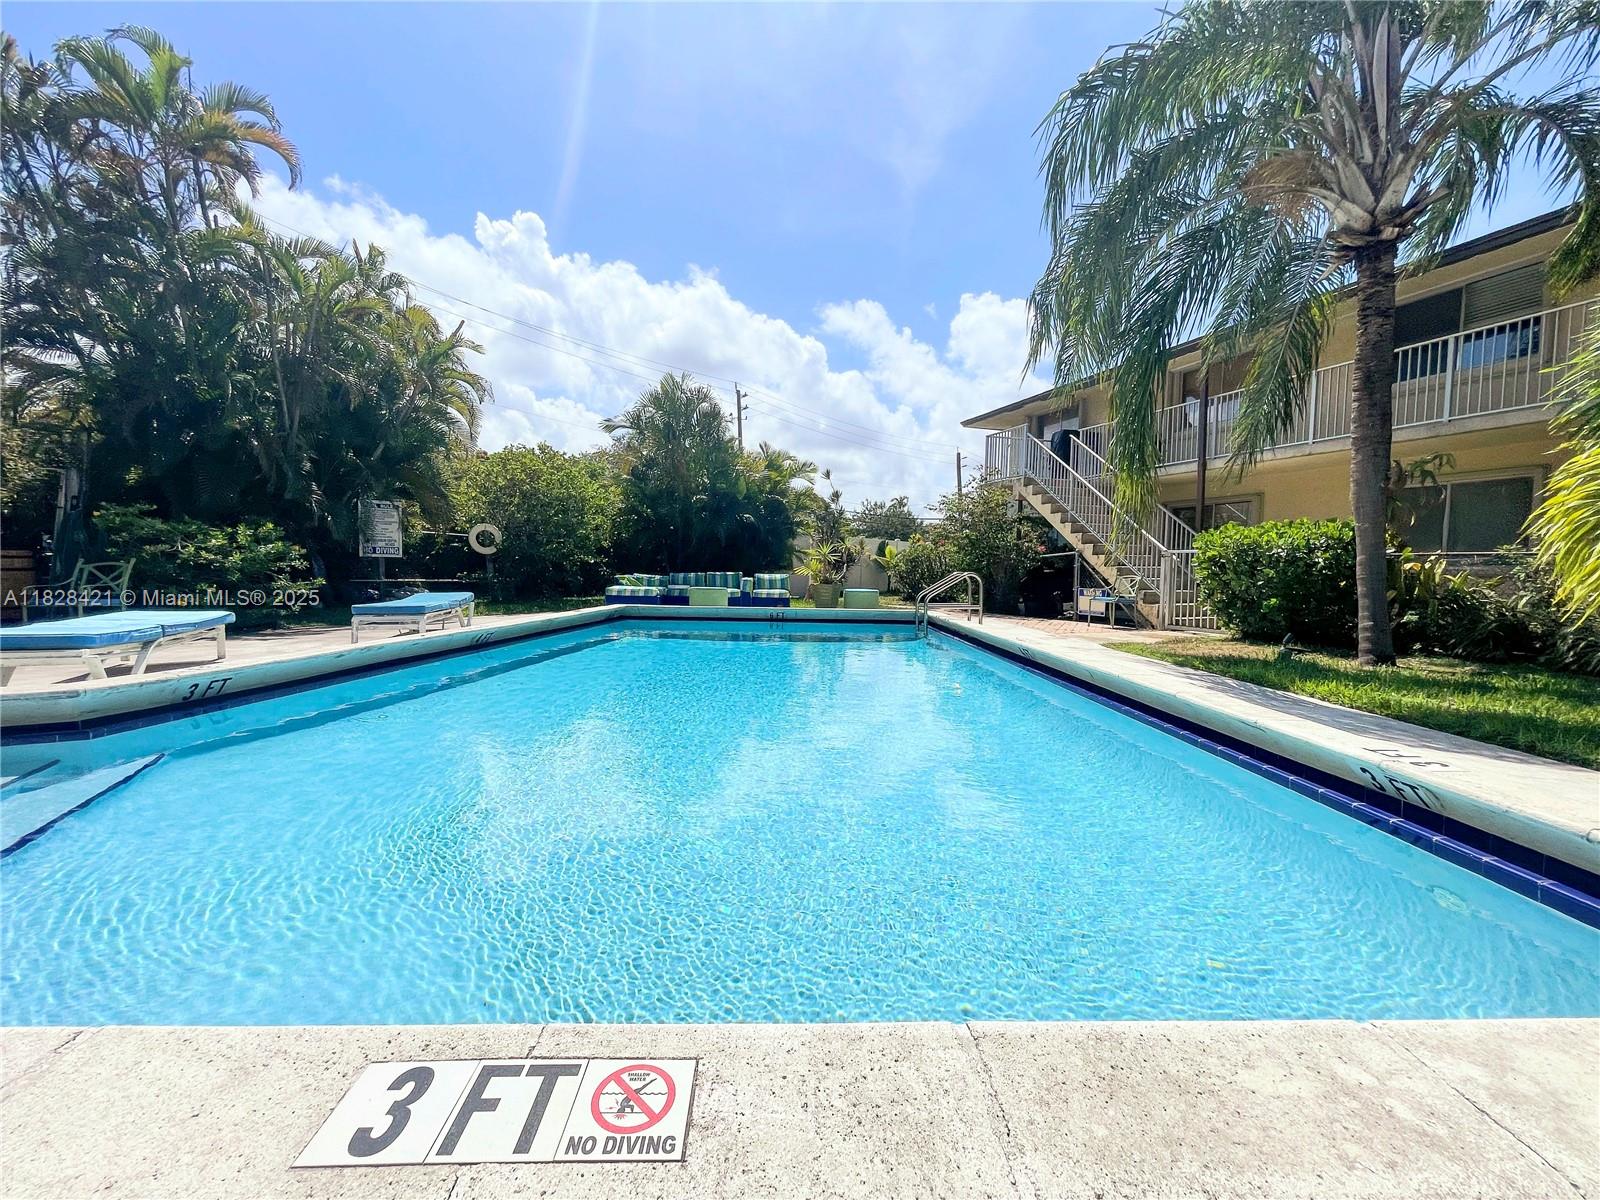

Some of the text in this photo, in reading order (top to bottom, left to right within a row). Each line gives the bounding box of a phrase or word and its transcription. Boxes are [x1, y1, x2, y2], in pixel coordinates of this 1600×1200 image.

[182, 677, 233, 701] 3 FT
[1359, 766, 1431, 809] 3 FT
[347, 1064, 582, 1158] 3 FT
[564, 1135, 677, 1155] NO DIVING
